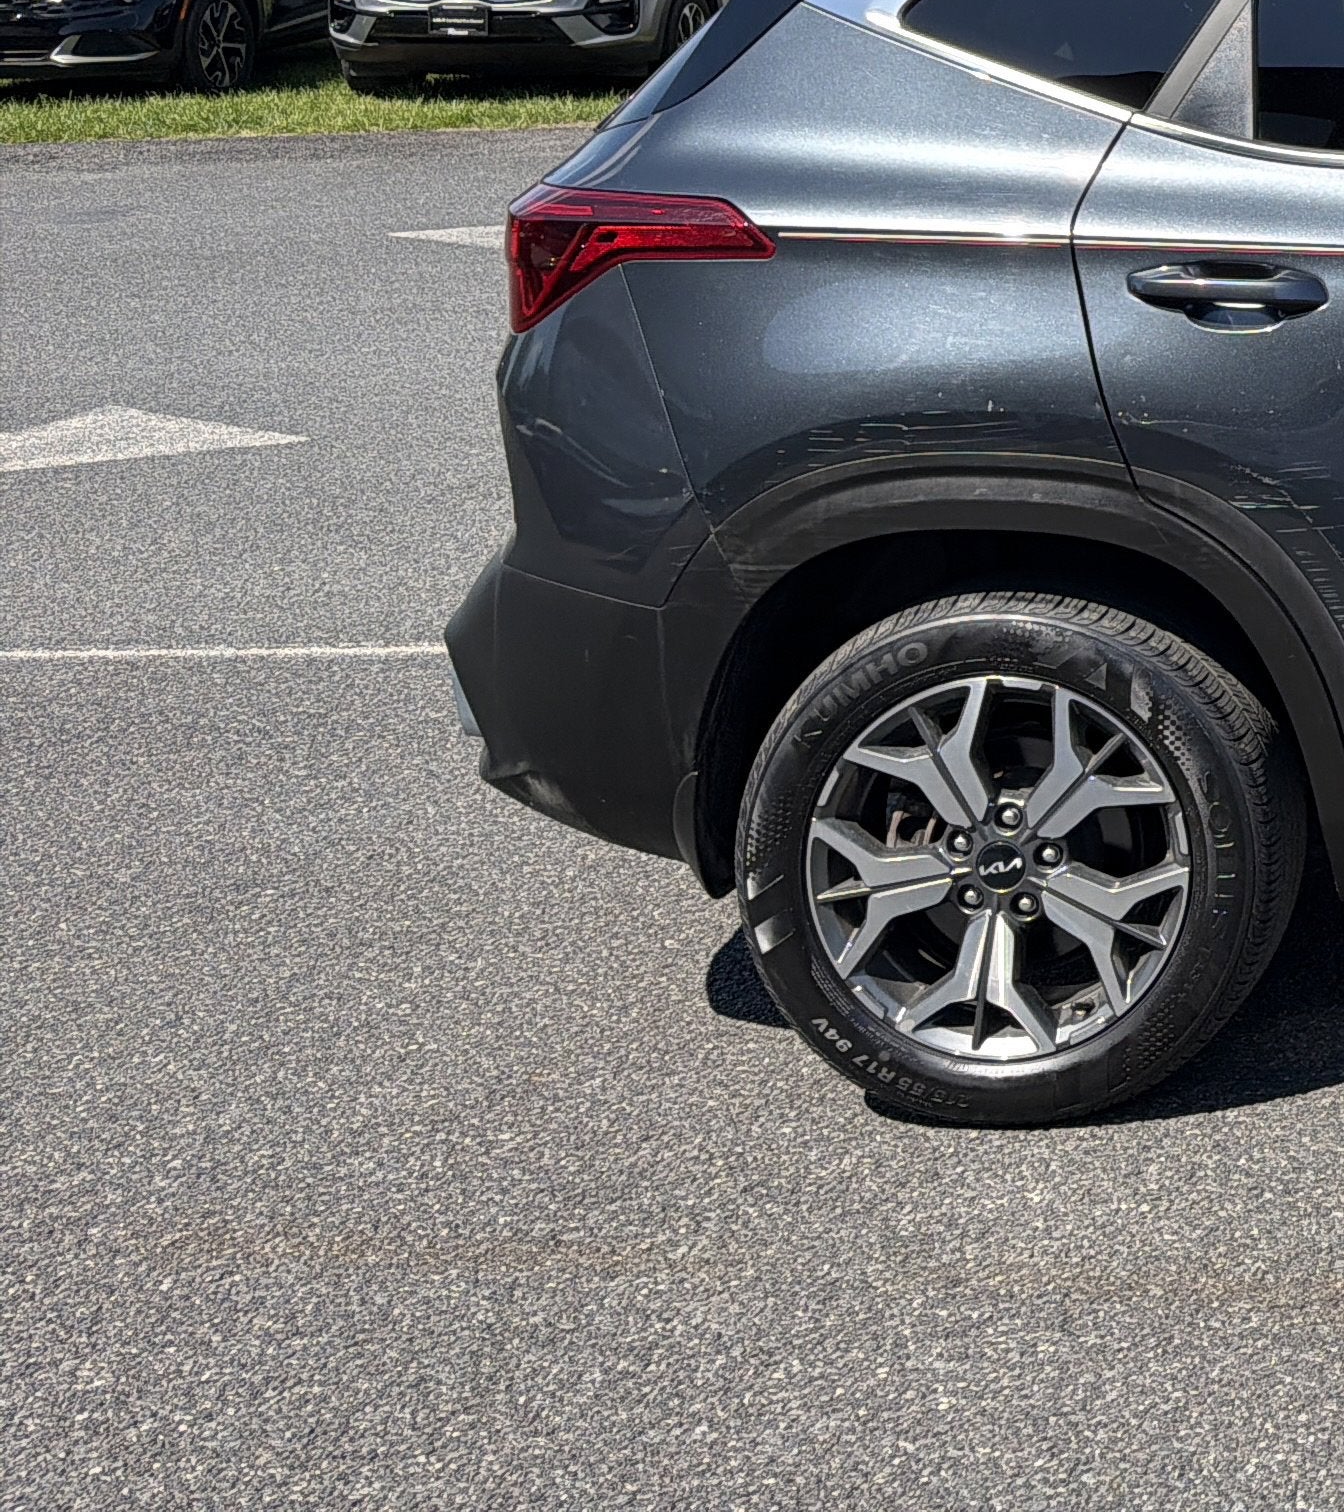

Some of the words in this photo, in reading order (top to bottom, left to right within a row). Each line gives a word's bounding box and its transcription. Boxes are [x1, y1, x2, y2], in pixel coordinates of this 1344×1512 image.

[793, 641, 929, 749] KUMHO
[978, 856, 1023, 876] KIA
[811, 1017, 853, 1053] 94V
[851, 1053, 897, 1084] R17
